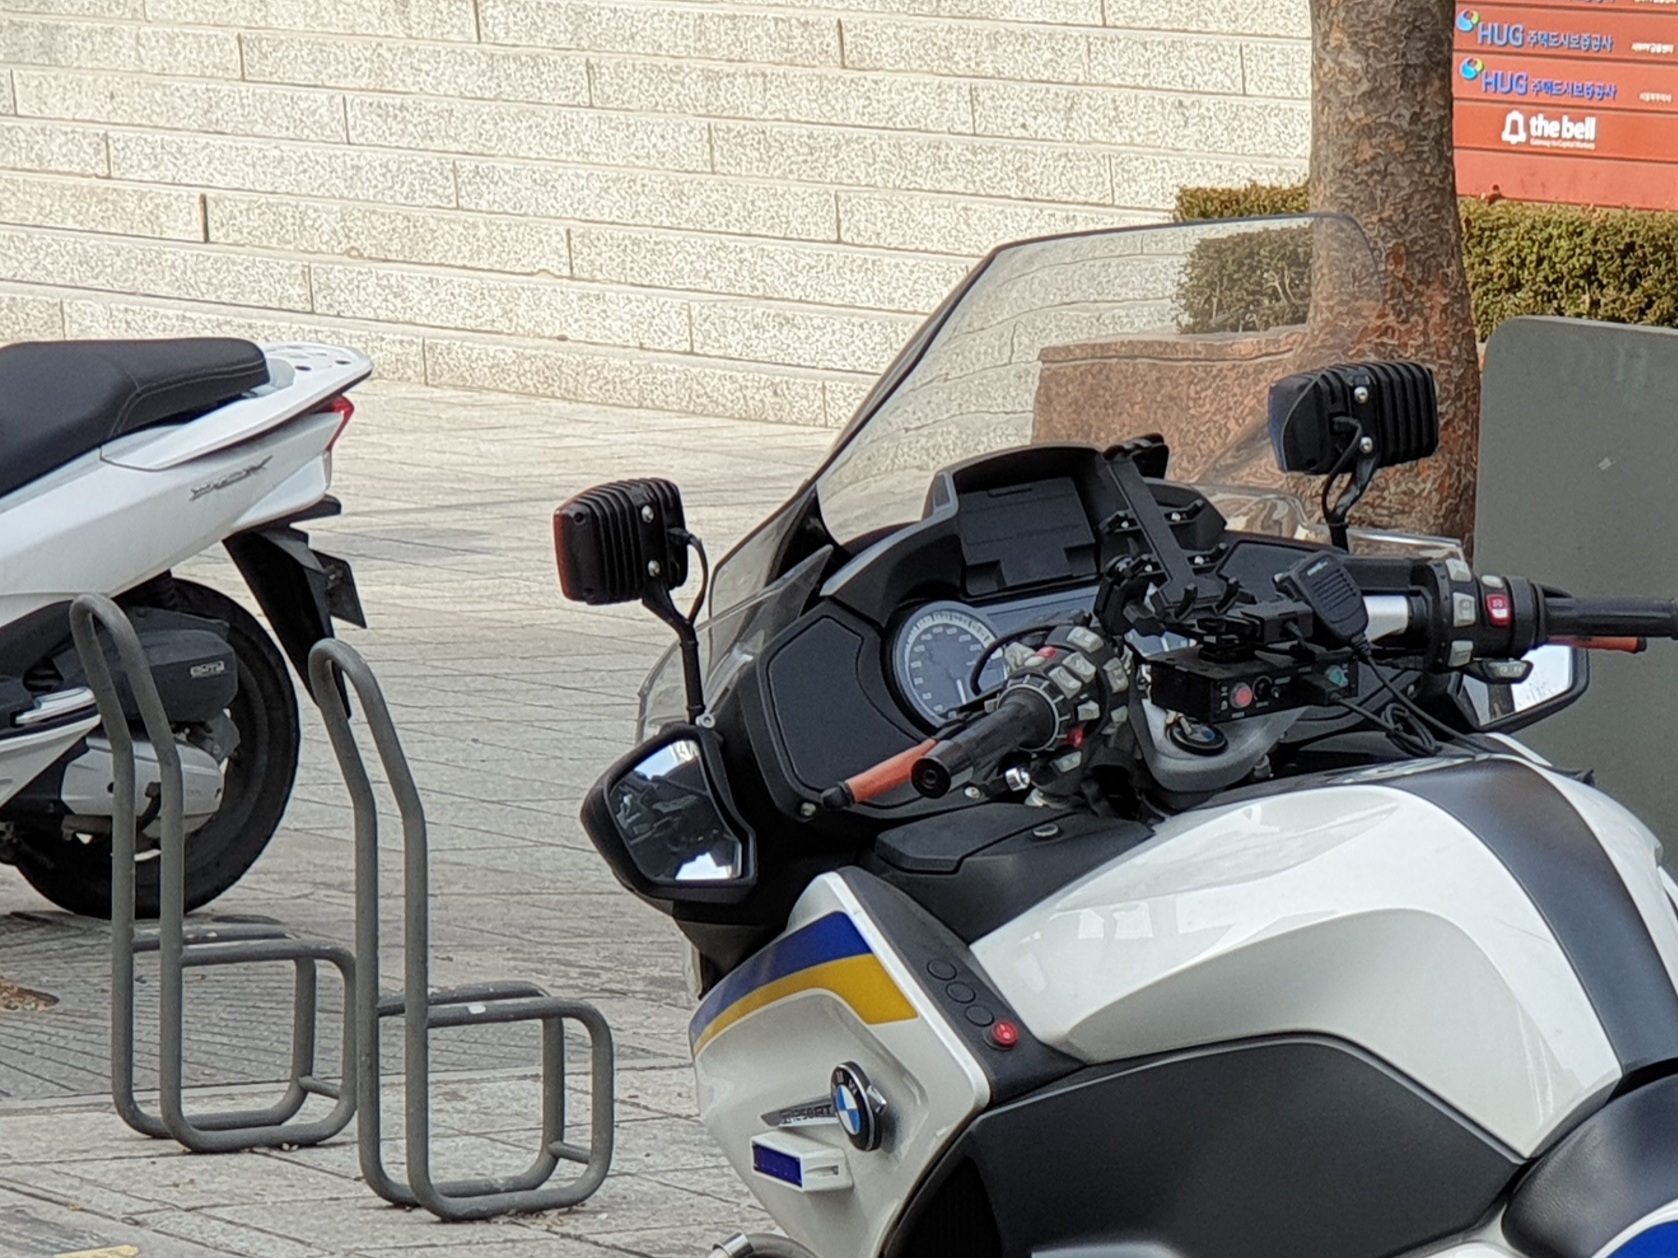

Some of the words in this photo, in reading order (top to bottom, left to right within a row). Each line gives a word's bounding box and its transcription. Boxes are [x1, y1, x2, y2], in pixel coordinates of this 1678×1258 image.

[1478, 22, 1525, 47] HUG
[1528, 29, 1614, 53] 주택도시보증공사
[1482, 71, 1528, 95] HUG
[1531, 78, 1618, 101] 주택도시보증공사
